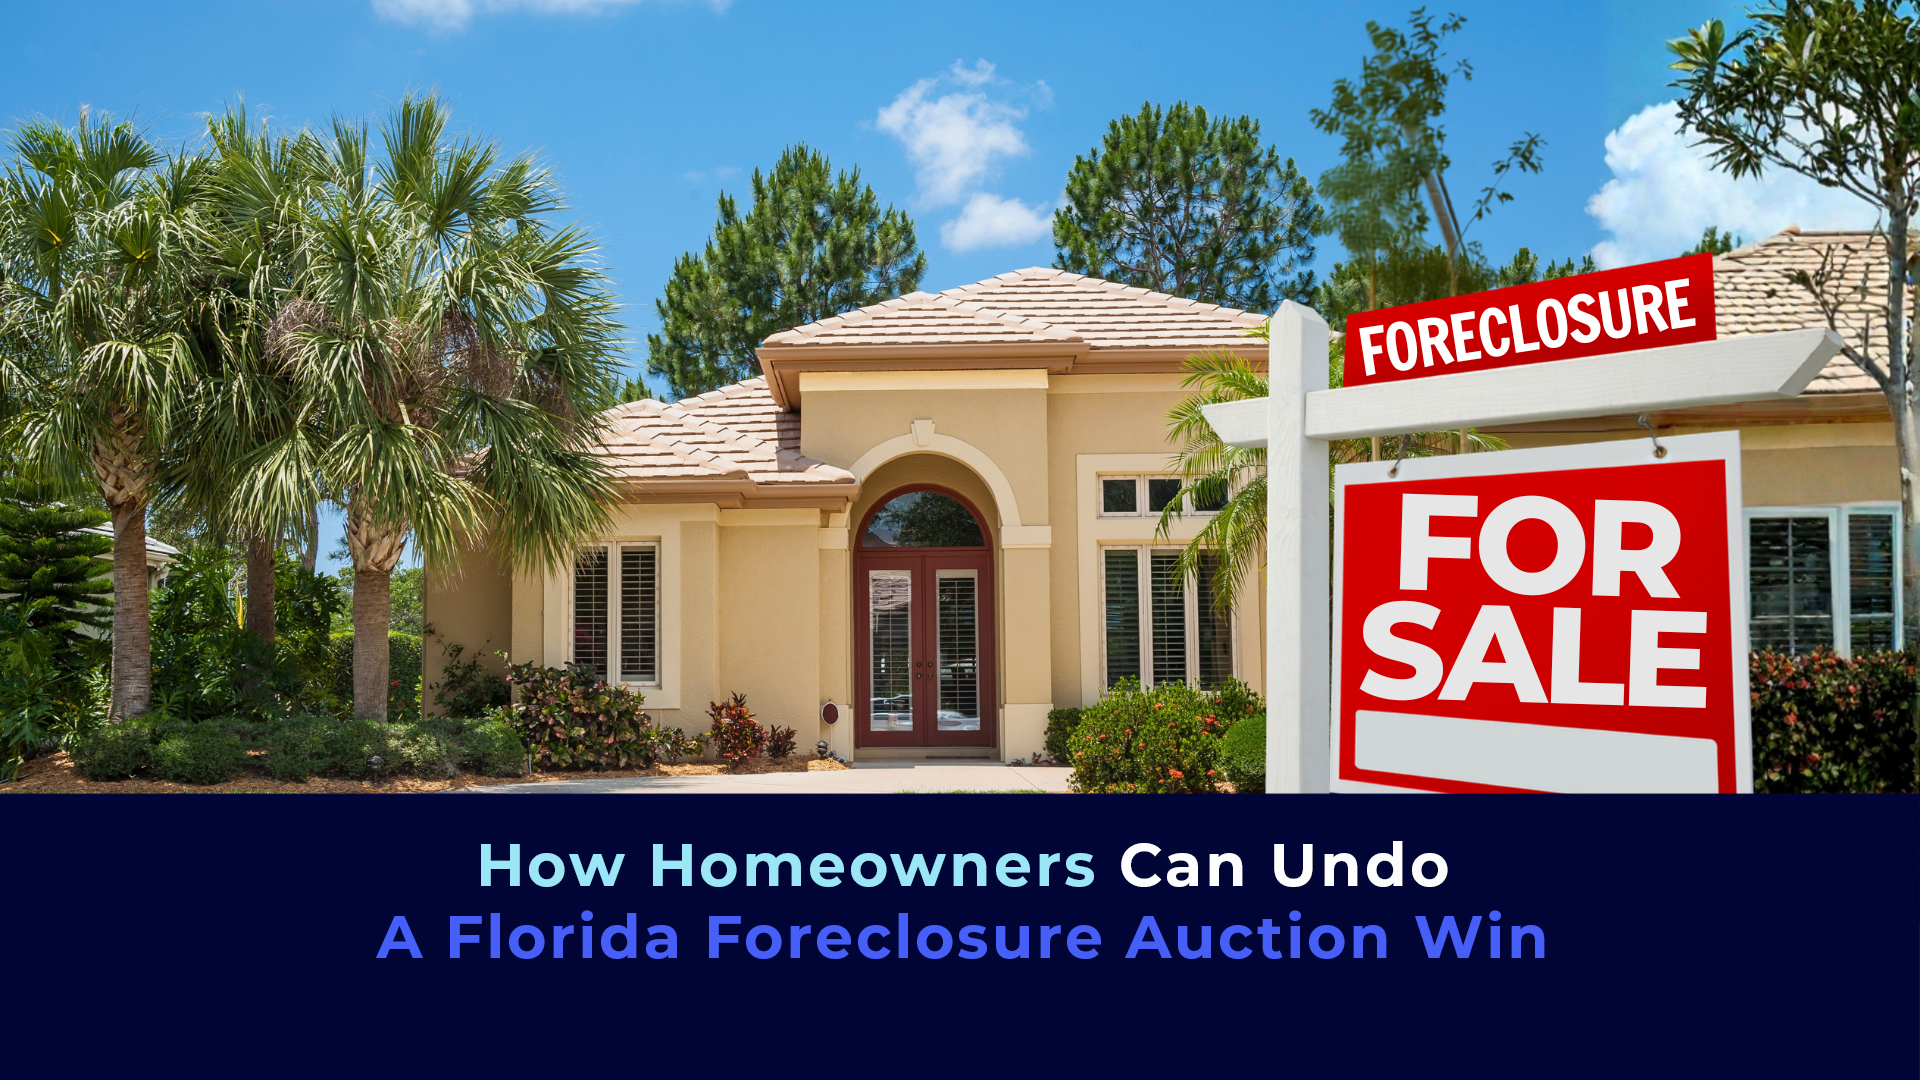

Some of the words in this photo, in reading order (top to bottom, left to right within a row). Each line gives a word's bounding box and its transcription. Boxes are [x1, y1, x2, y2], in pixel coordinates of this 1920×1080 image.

[1359, 278, 1696, 377] FORECLOSURE
[1400, 494, 1681, 599] FOR
[1360, 601, 1708, 709] SALE
